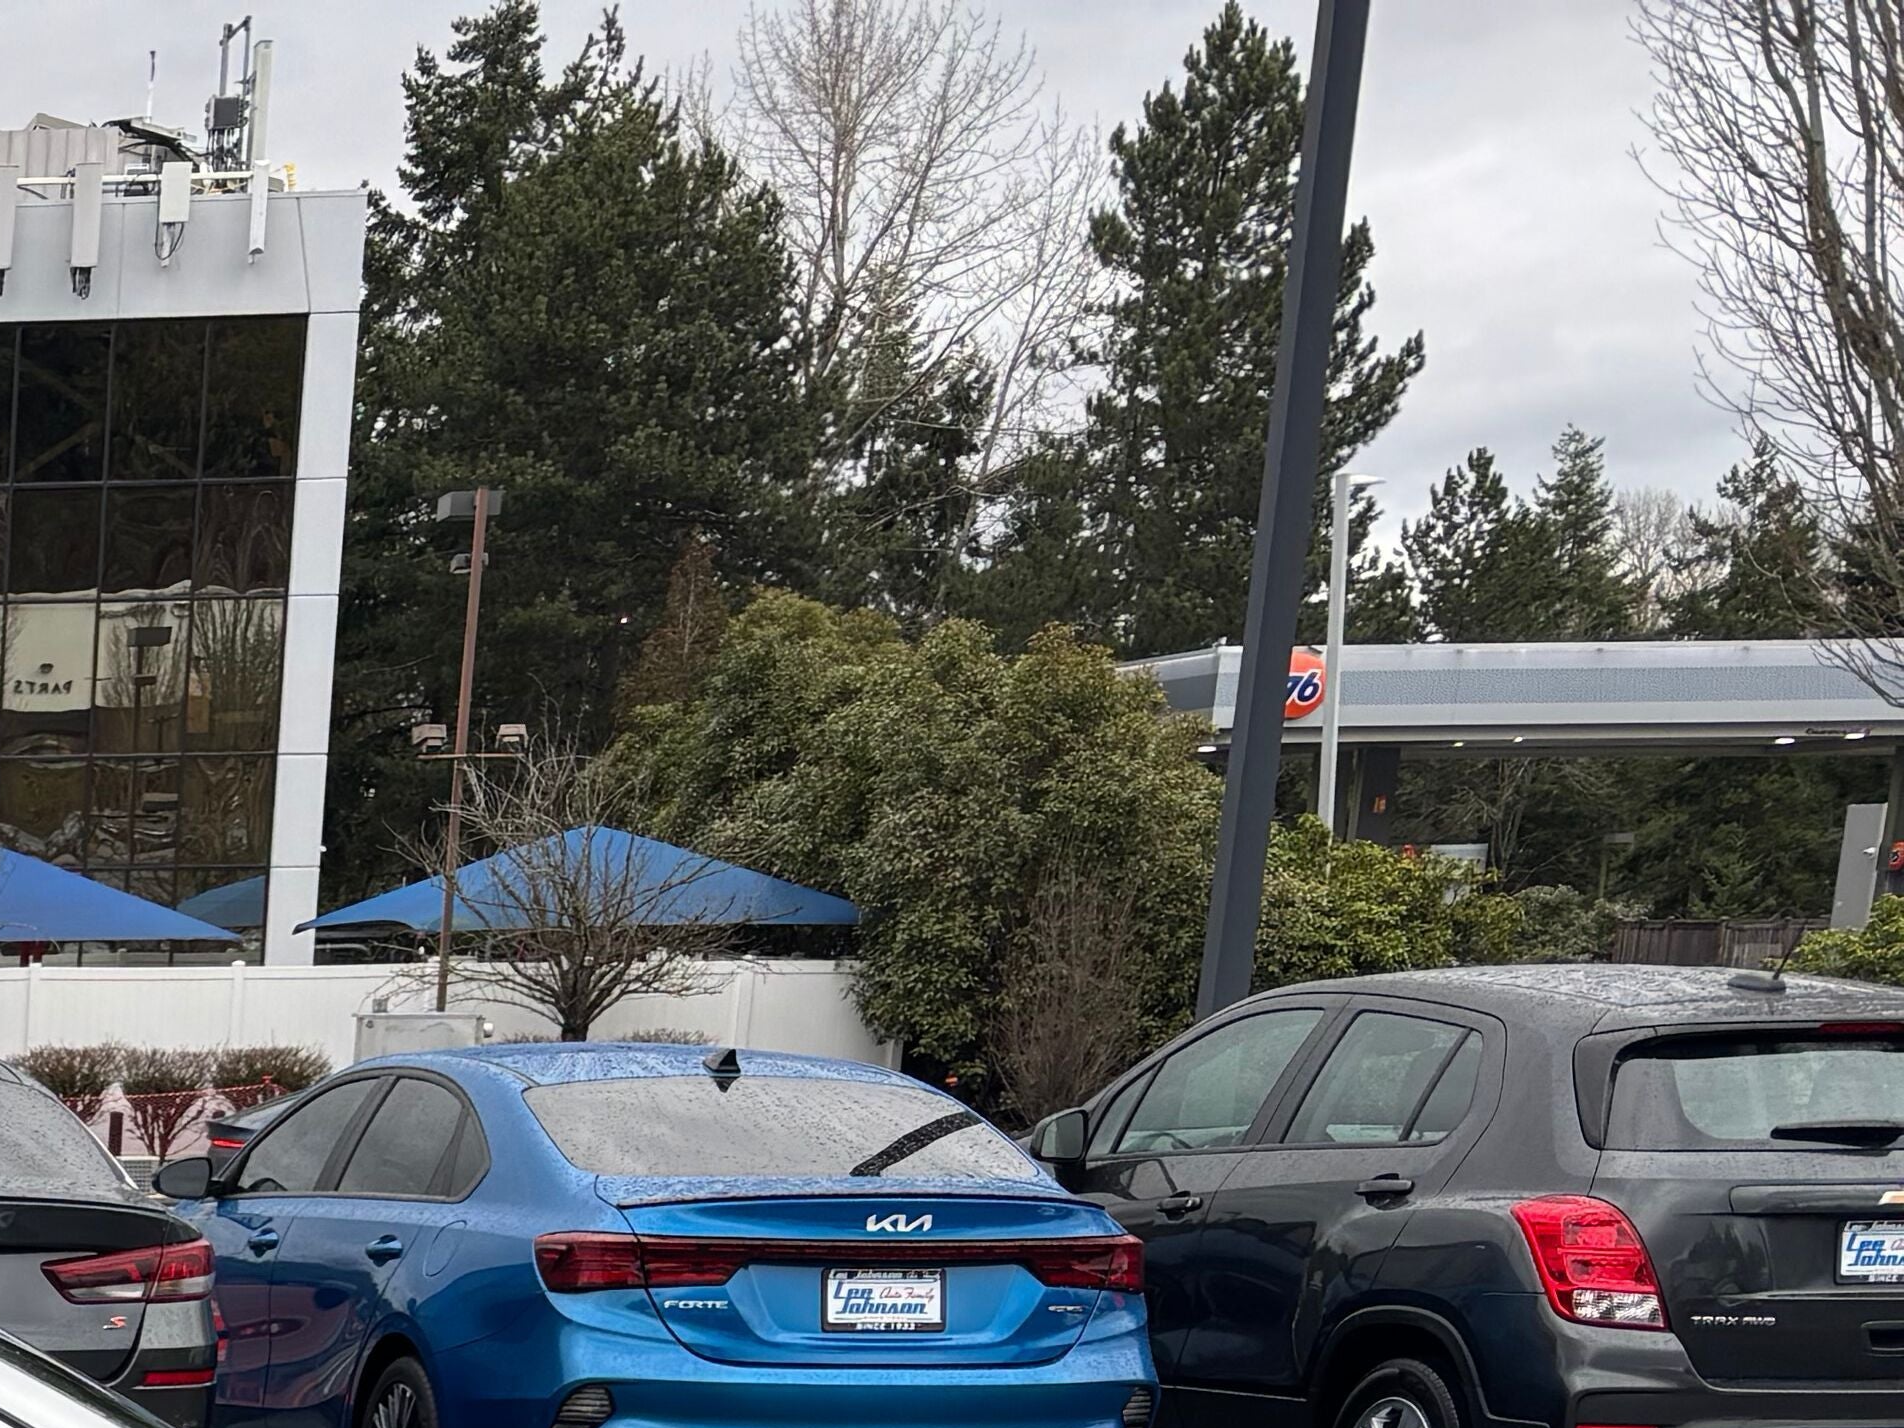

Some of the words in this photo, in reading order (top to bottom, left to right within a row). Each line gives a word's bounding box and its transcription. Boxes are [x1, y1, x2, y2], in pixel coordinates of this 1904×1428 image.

[1846, 1232, 1886, 1252] Lee
[833, 1281, 875, 1299] Lee
[663, 1300, 729, 1309] FORTE
[835, 1297, 929, 1315] Johnson
[1690, 1315, 1739, 1326] TRAX
[1742, 1316, 1776, 1326] AWD
